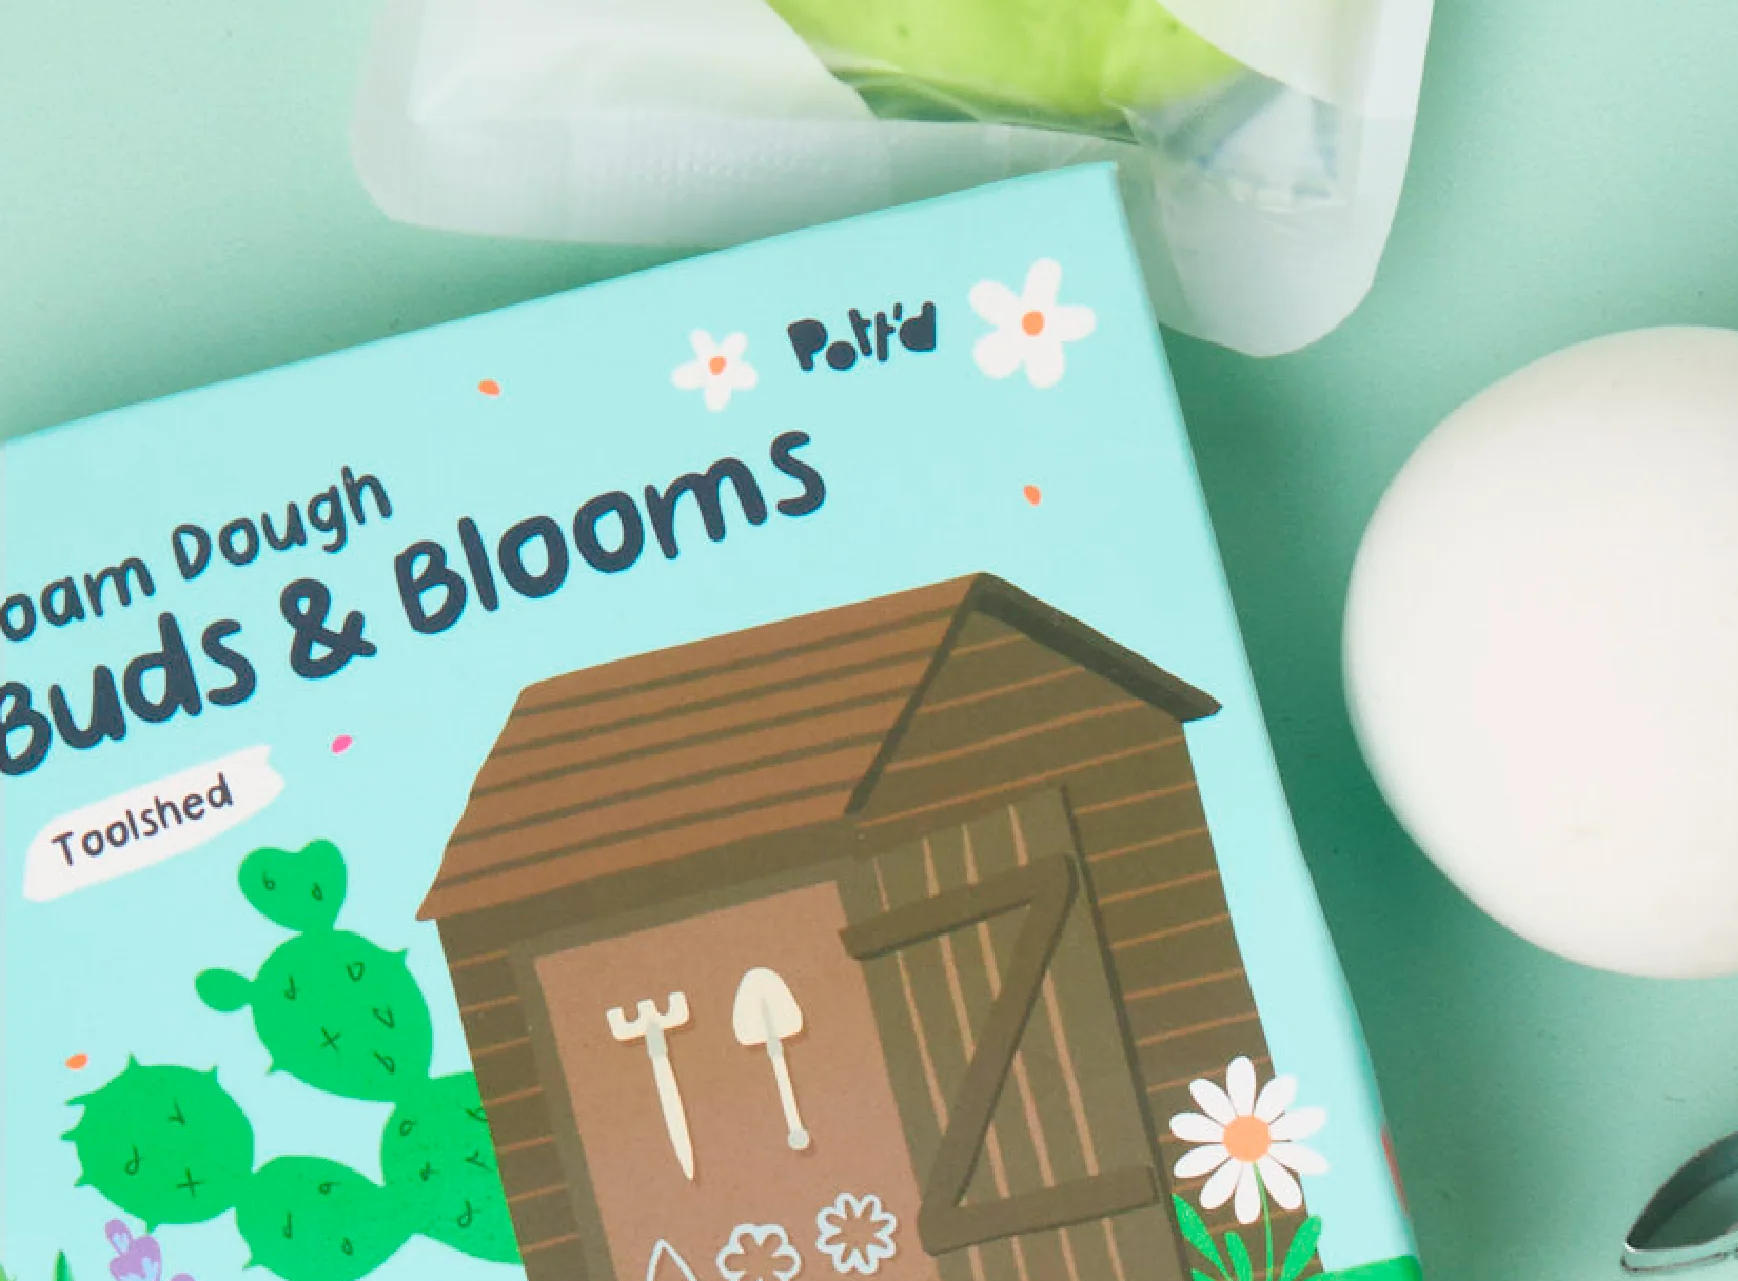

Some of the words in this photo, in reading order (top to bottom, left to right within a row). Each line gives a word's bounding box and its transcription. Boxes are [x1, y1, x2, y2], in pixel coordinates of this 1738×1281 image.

[787, 300, 937, 372] Pott'd
[0, 557, 155, 642] oam
[172, 465, 393, 580] Dough
[0, 612, 256, 776] Buds
[279, 578, 378, 679] &
[393, 430, 827, 635] Blooms
[51, 772, 234, 867] Toolshed
